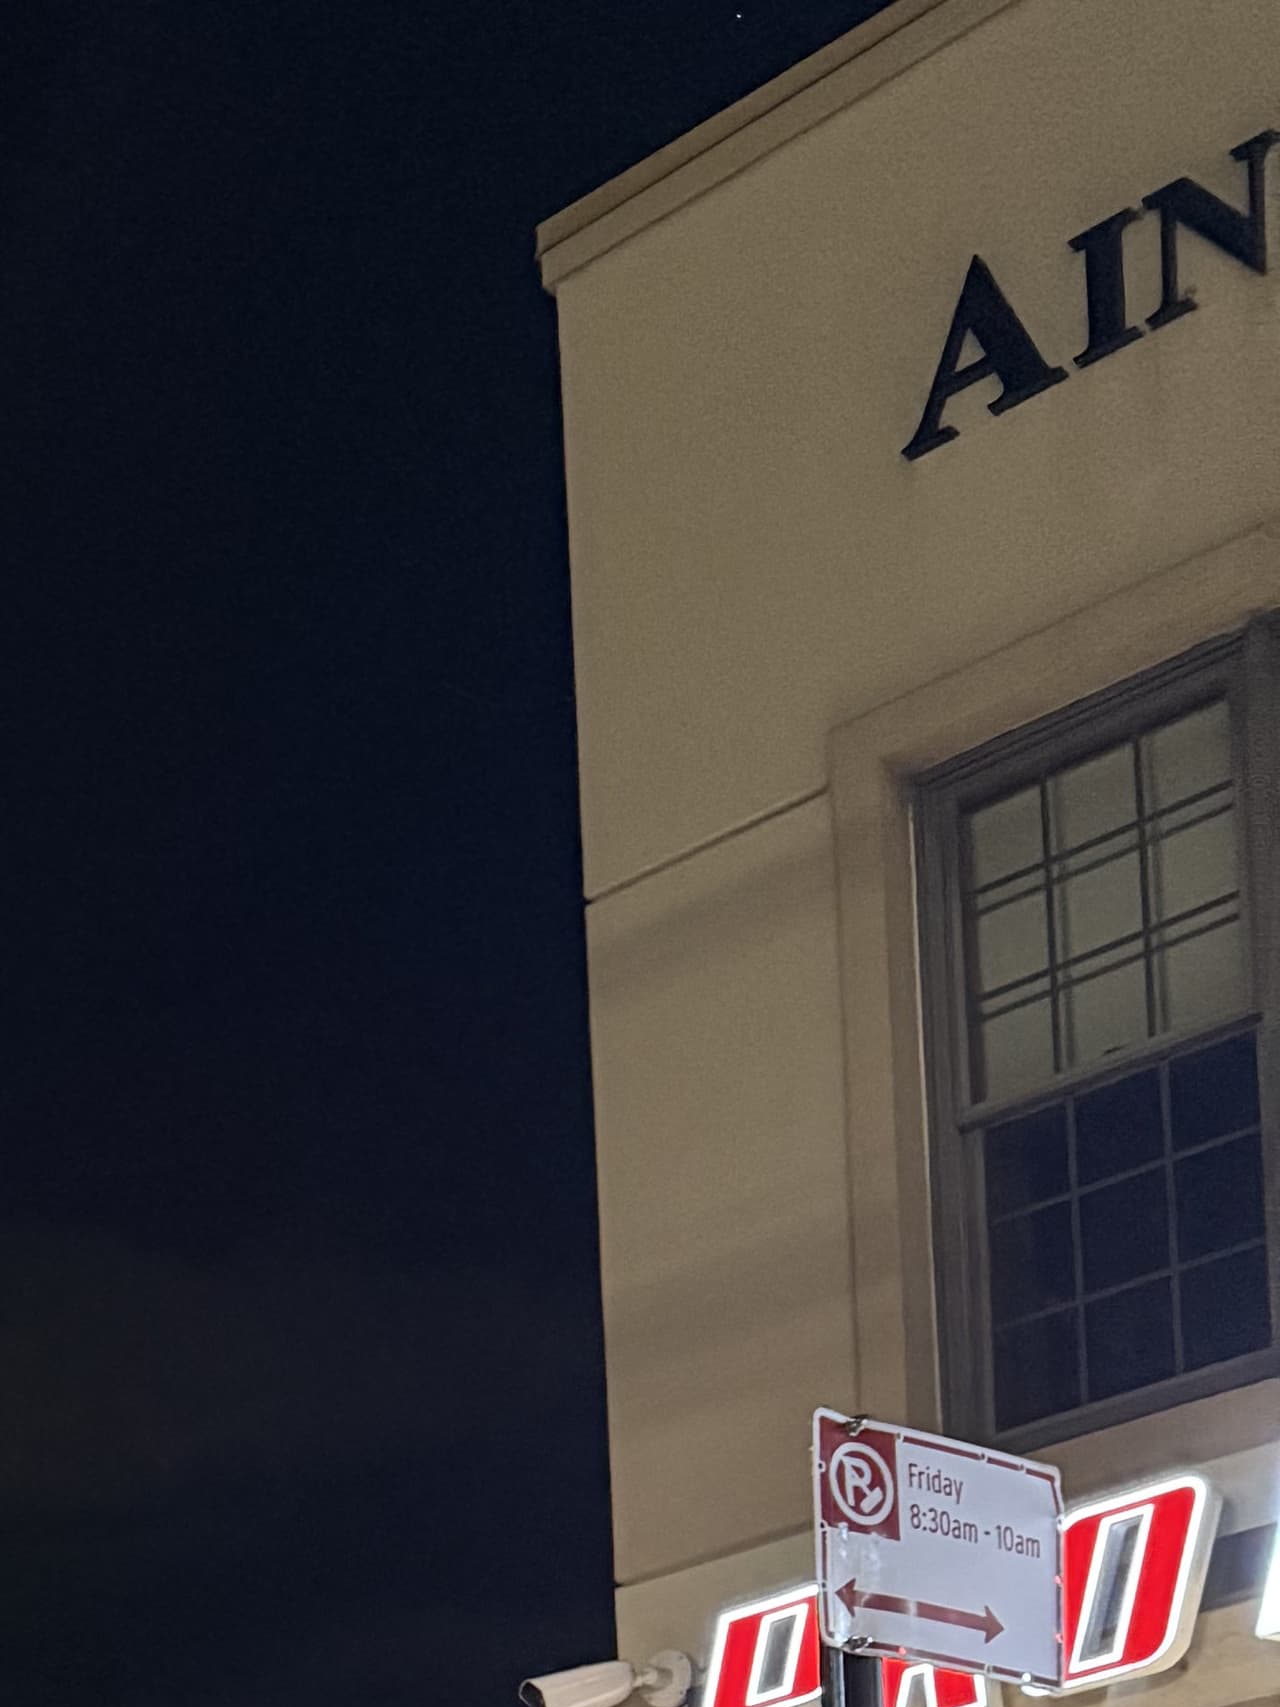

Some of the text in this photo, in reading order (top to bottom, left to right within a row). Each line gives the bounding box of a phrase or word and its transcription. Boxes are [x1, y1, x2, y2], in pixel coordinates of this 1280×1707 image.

[908, 1462, 963, 1505] Friday
[910, 1503, 978, 1544] 8:30am
[995, 1524, 1041, 1559] 10am
